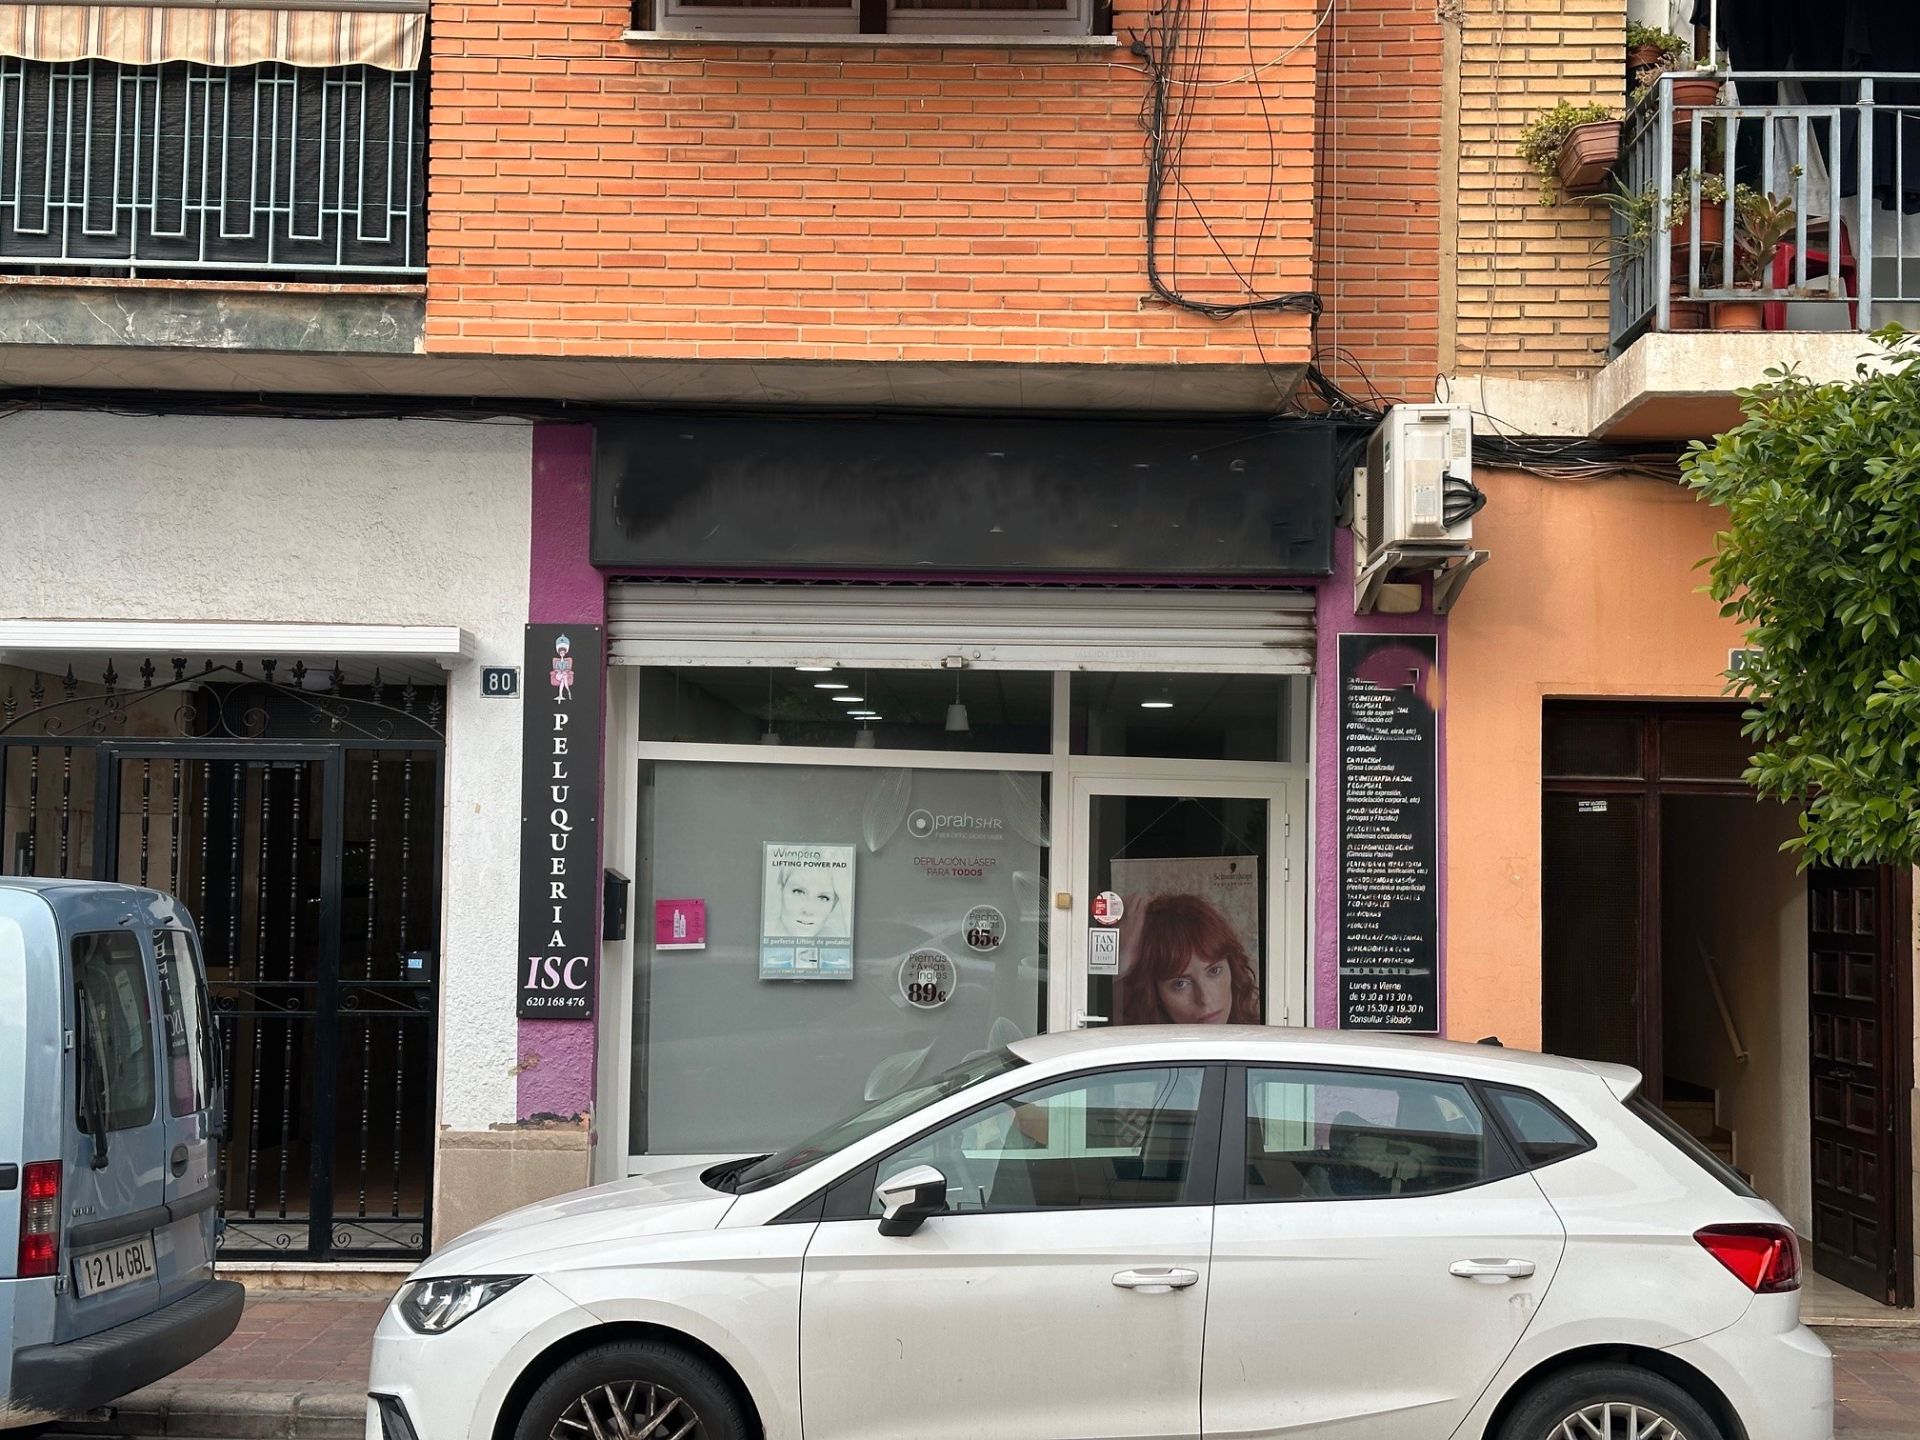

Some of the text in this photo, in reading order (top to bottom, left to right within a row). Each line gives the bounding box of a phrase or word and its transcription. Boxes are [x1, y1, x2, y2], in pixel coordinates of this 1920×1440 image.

[489, 672, 511, 691] 80
[548, 713, 573, 947] PELUQUERIA
[926, 867, 983, 877] PARA TODOS
[1094, 935, 1114, 944] TAN
[1095, 943, 1114, 953] INO
[524, 956, 589, 990] ISC
[1349, 982, 1371, 990] Lunes
[908, 983, 947, 1003] 89€
[1349, 992, 1358, 1001] de
[1407, 993, 1413, 1001] h
[526, 997, 585, 1007] 620 168 476
[1349, 1005, 1355, 1013] y
[1355, 1004, 1365, 1012] de
[1366, 1003, 1388, 1013] 15.30
[1396, 1004, 1417, 1013] 19.30
[1418, 1004, 1424, 1013] h
[85, 1244, 151, 1290] 1214 GBL
